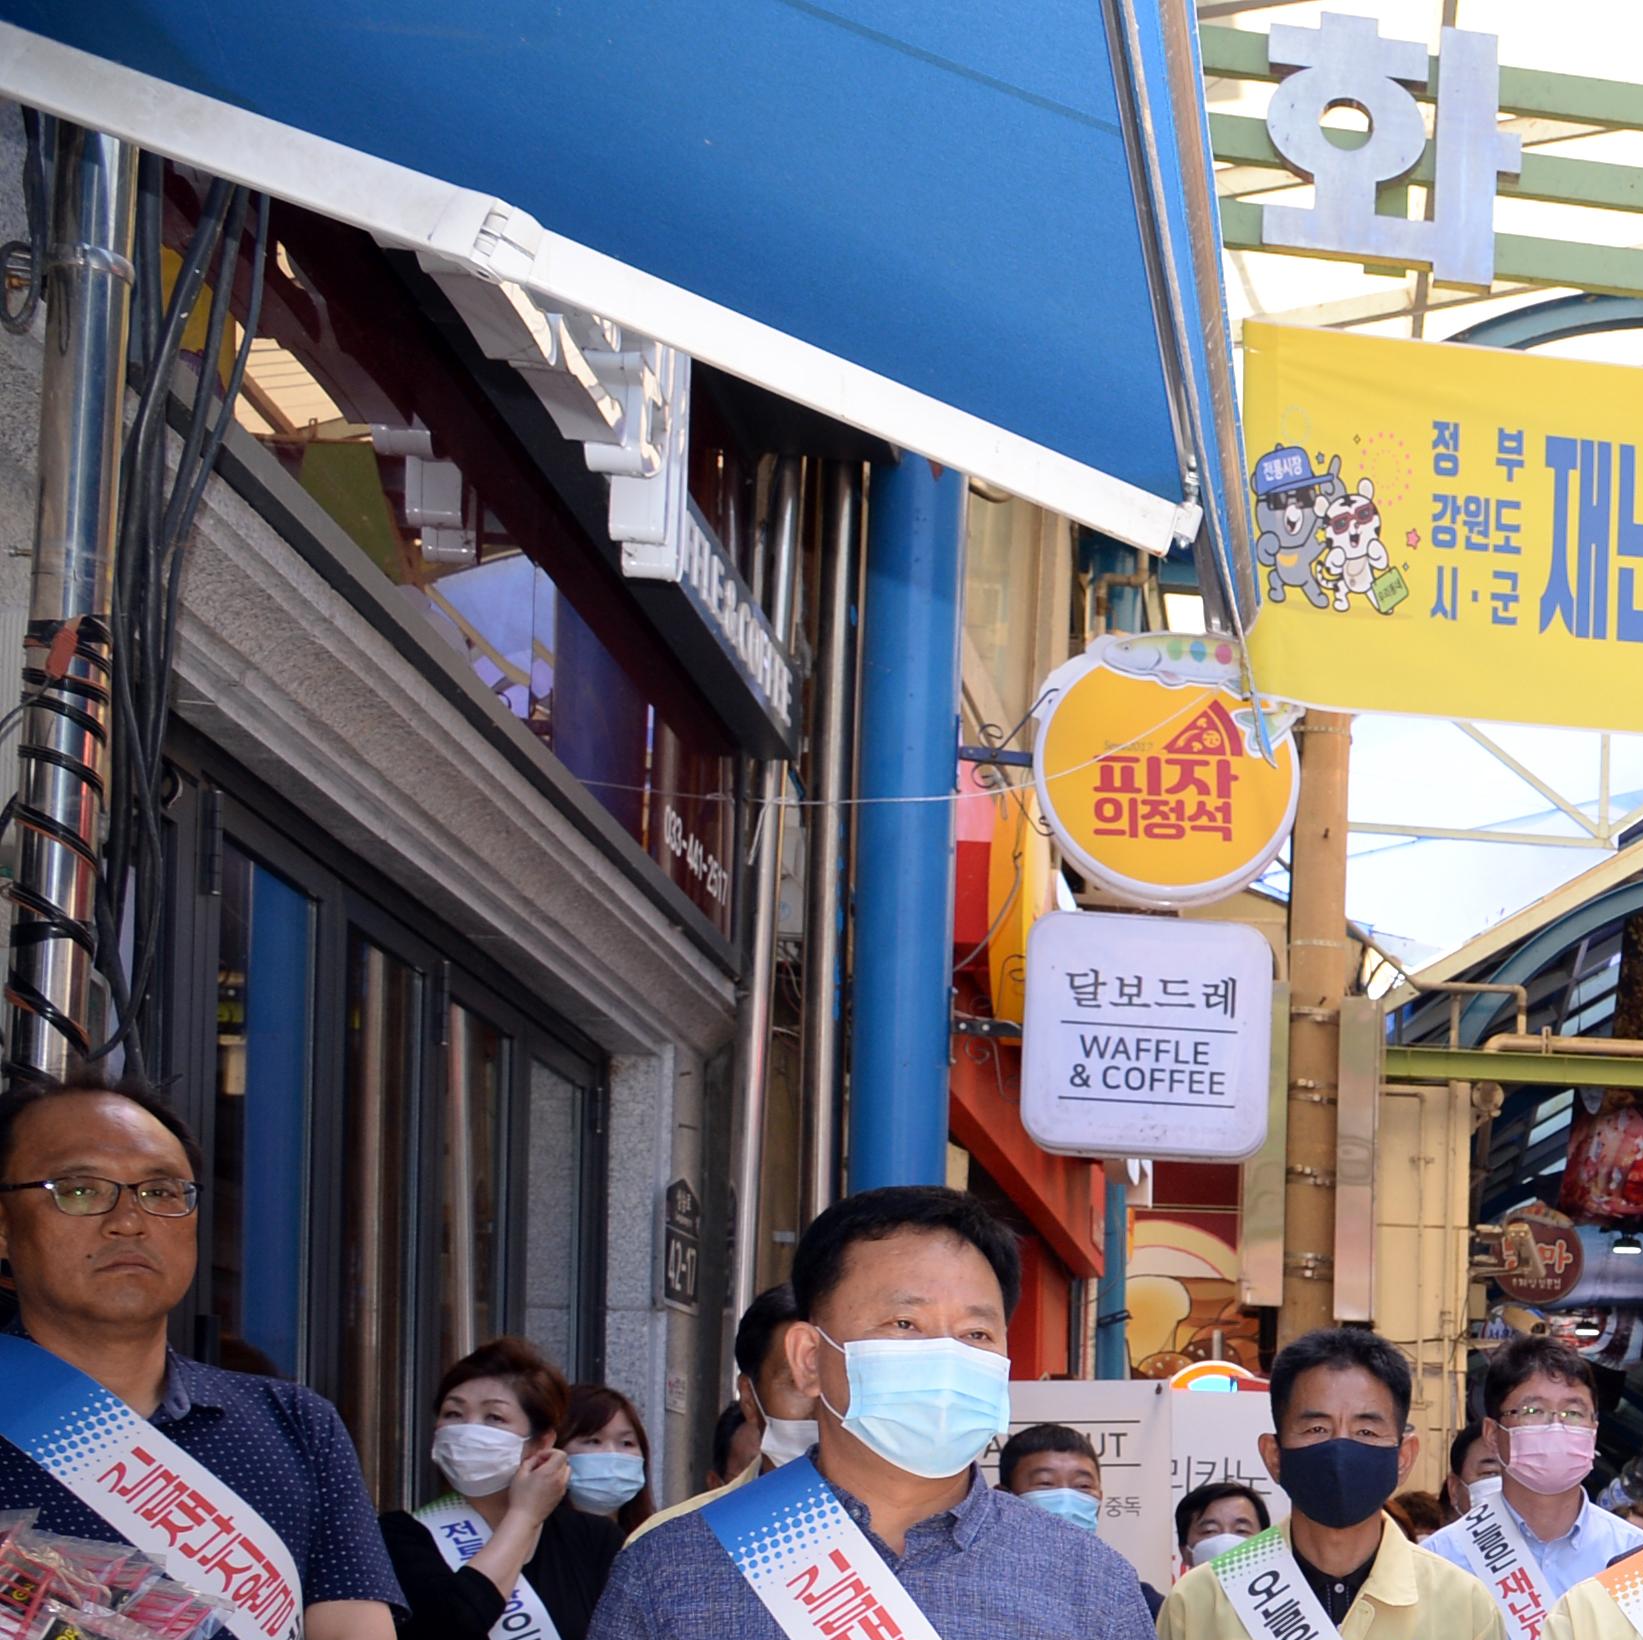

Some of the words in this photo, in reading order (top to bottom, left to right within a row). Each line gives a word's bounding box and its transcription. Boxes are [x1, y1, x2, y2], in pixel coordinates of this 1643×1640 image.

[1431, 494, 1522, 555] 강원도
[1093, 755, 1239, 799] 피자
[1093, 797, 1232, 842] 의정석
[1065, 968, 1239, 1019] 달보드레
[1079, 1034, 1211, 1066] WAFFLE
[1069, 1063, 1092, 1089] &
[1102, 1065, 1227, 1097] COFFEE
[97, 1446, 296, 1638] 긴급재난지원금
[1465, 1502, 1518, 1575] 오늘은
